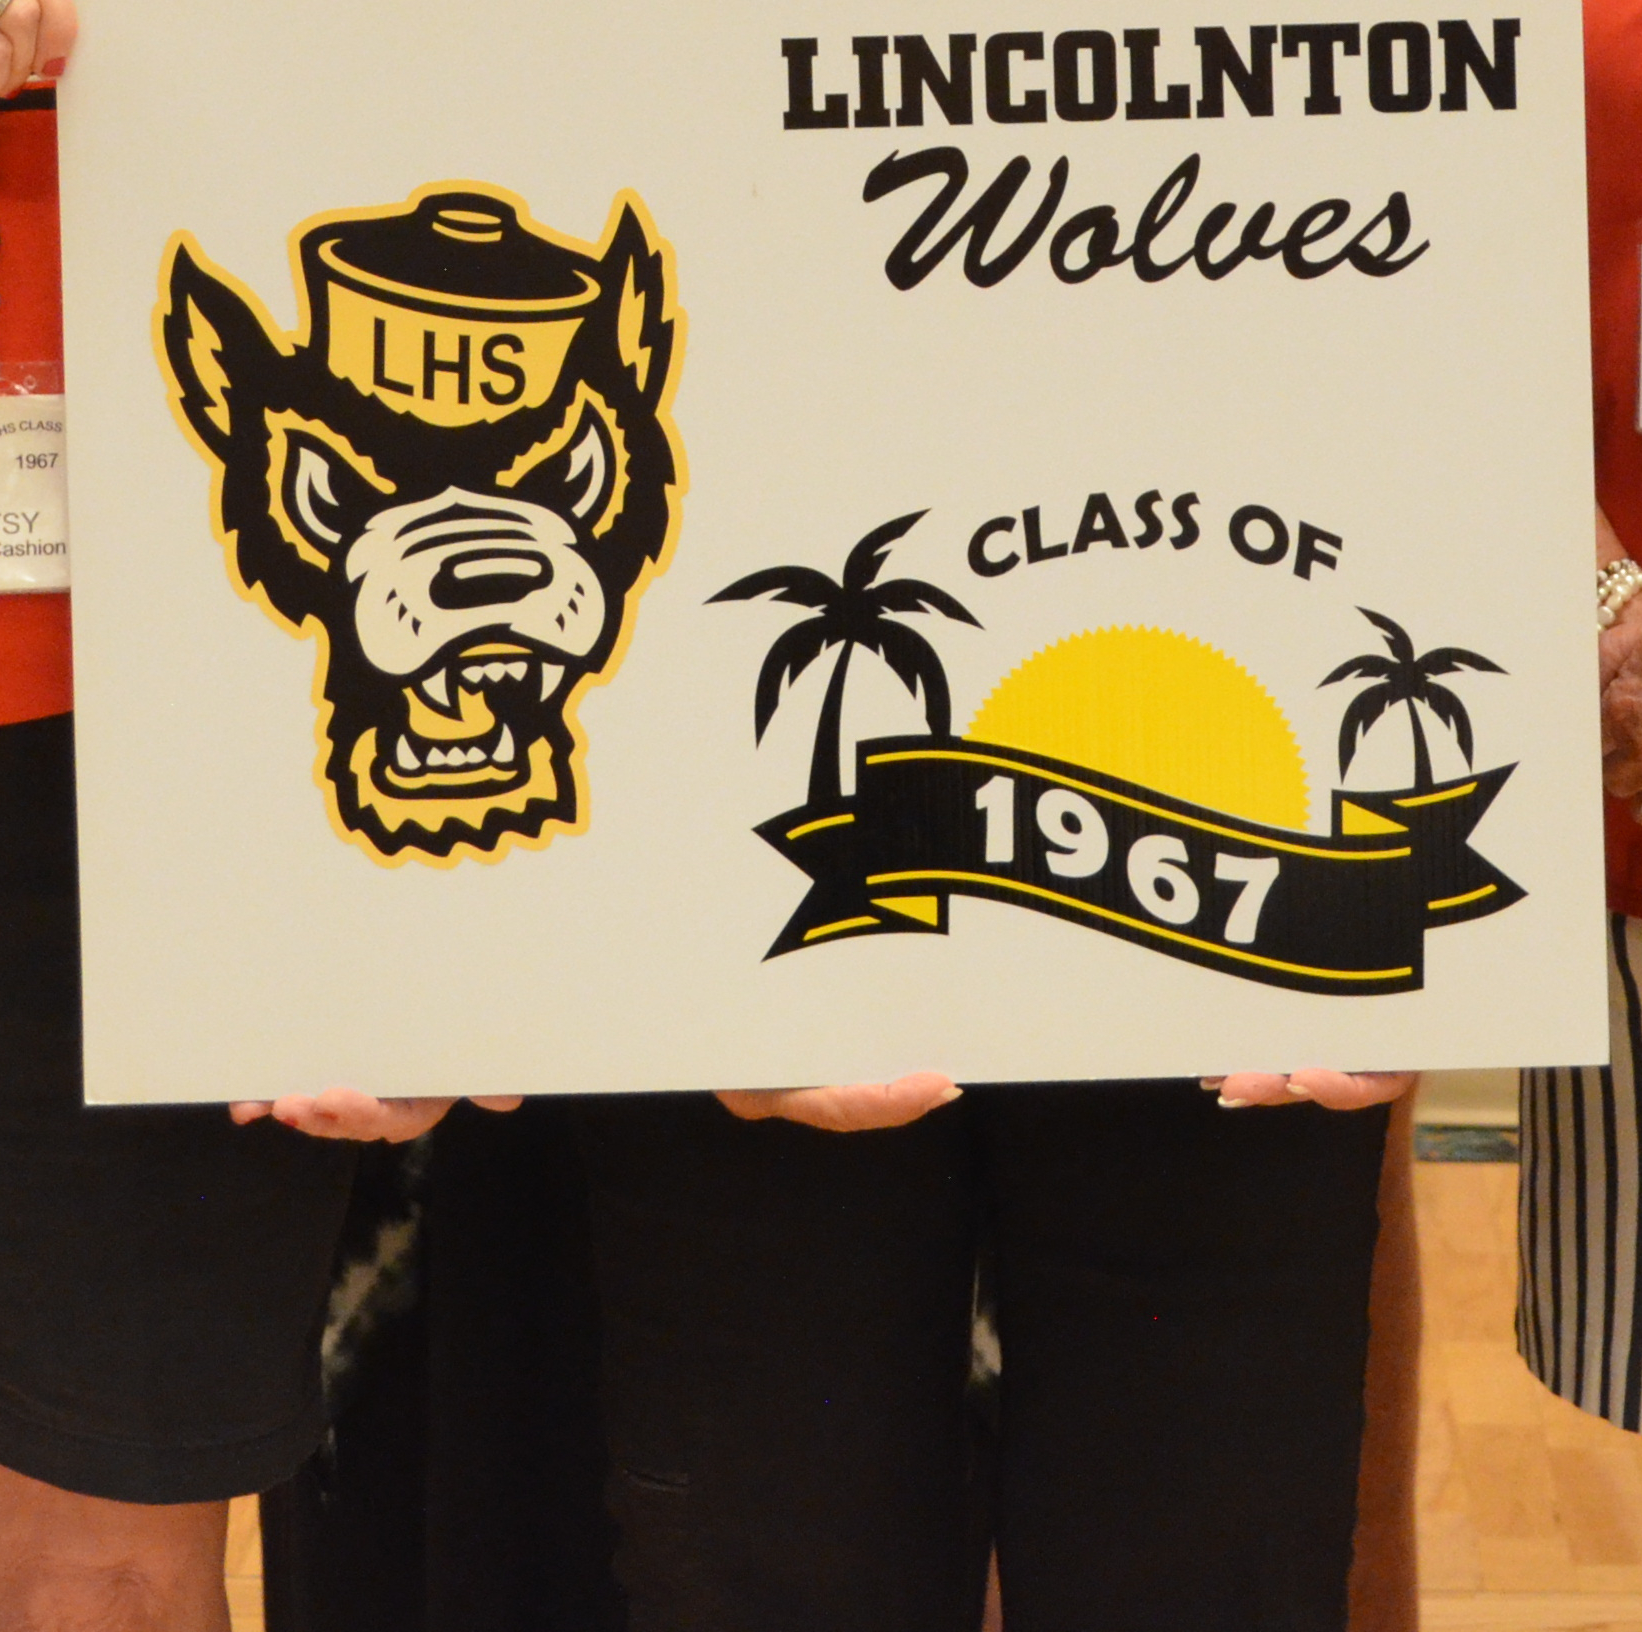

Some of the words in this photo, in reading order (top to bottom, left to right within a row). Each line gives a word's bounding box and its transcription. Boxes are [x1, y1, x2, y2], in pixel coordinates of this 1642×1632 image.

[781, 18, 1522, 131] LINCOLNTON
[862, 146, 1431, 291] Wolves
[373, 317, 526, 406] LHS
[15, 452, 59, 470] 1967
[19, 420, 65, 434] CLASS
[966, 489, 1200, 578] CLASS
[1228, 504, 1343, 581] OF
[974, 774, 1280, 946] 1967
